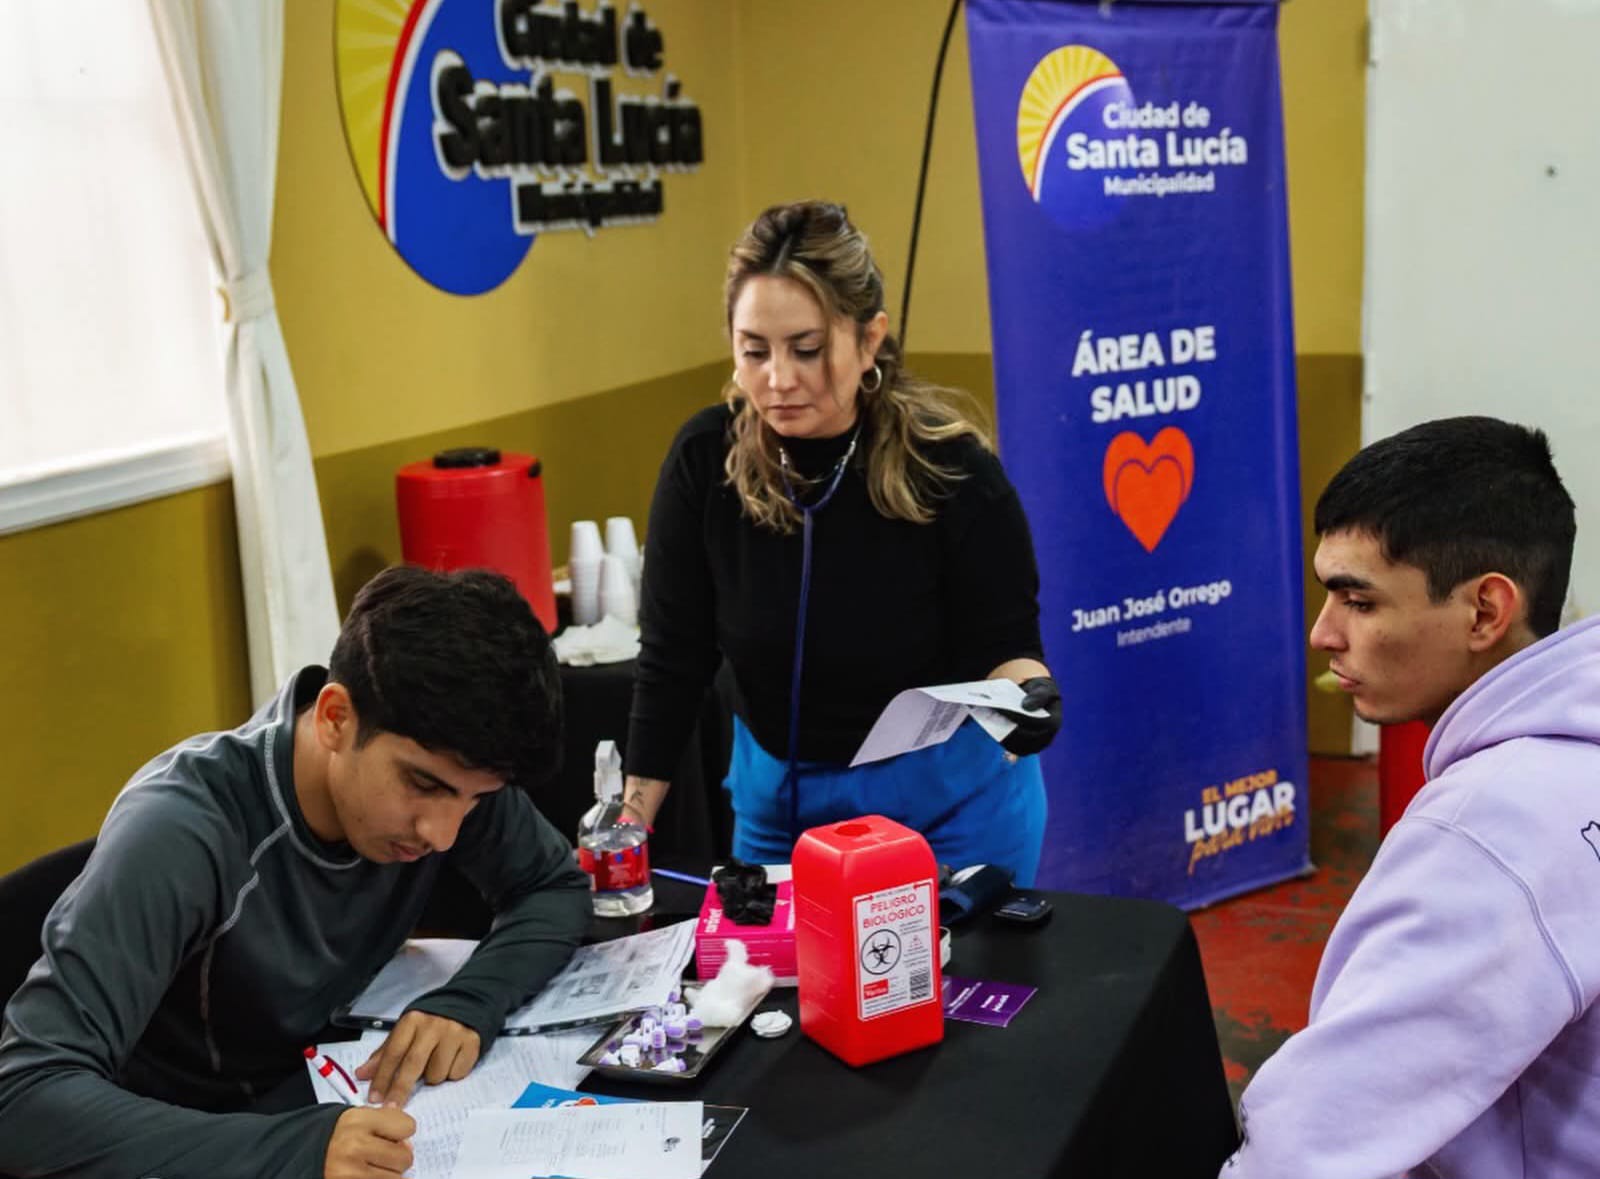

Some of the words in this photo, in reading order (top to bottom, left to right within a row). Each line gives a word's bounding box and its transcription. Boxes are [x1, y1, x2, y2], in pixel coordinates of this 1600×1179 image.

[622, 1, 664, 77] de
[430, 50, 588, 181] Santa
[590, 73, 705, 175] Lucía
[1102, 101, 1180, 129] Ciudad
[1182, 101, 1211, 128] de
[1066, 132, 1160, 170] Santa
[1166, 127, 1248, 166] Lucía
[1104, 171, 1215, 197] Municipalidad
[1072, 329, 1165, 377] ÁREA
[1169, 324, 1217, 365] DE
[1091, 375, 1201, 423] SALUD
[1071, 604, 1121, 633] Juan
[1123, 590, 1166, 620] José
[1167, 579, 1232, 606] Orrego
[1117, 618, 1192, 646] Intendente
[1184, 781, 1296, 843] LUGAR
[863, 904, 926, 929] BIOLOGICO
[871, 893, 917, 913] PELIGRO
